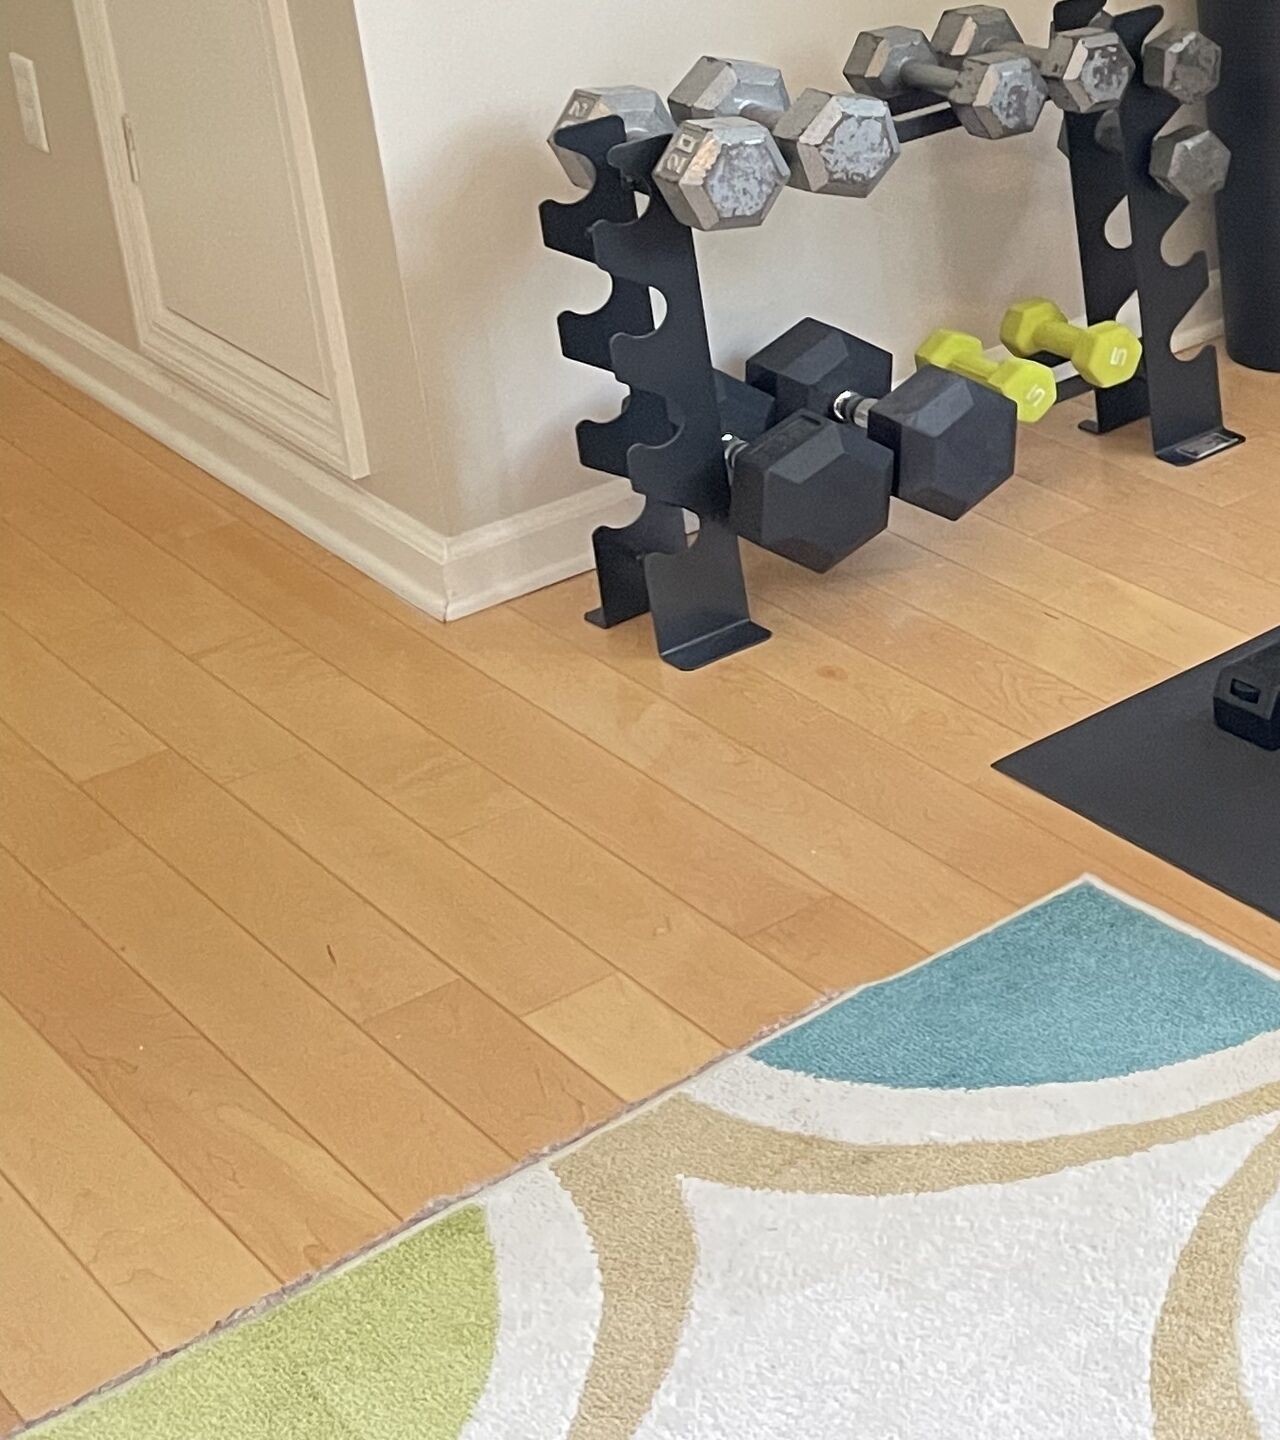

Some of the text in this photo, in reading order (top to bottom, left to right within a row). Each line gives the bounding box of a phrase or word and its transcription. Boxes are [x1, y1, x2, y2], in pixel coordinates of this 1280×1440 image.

[667, 133, 696, 174] 20
[1110, 346, 1128, 367] 5
[1026, 383, 1046, 407] 5
